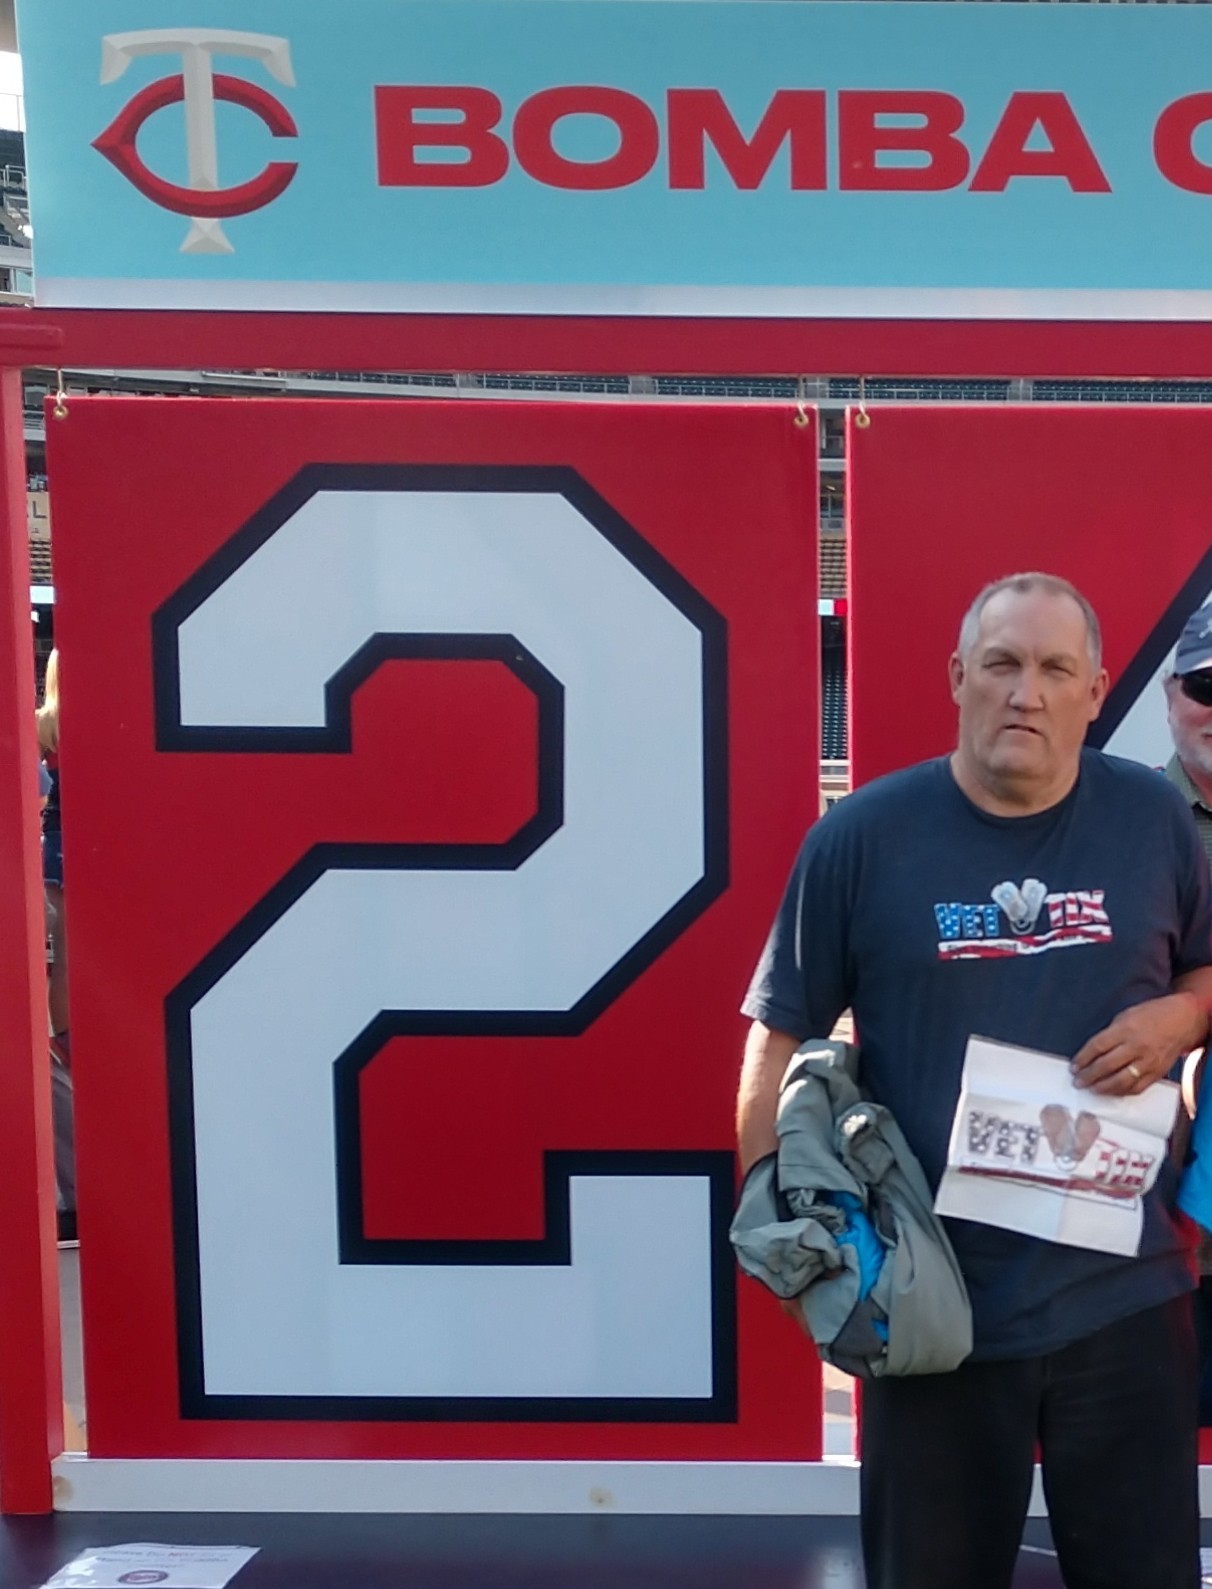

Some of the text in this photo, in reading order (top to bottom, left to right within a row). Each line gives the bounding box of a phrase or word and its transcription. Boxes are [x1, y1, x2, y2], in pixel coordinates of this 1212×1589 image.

[373, 84, 1112, 194] BOMBA
[934, 889, 1110, 939] VET TIX
